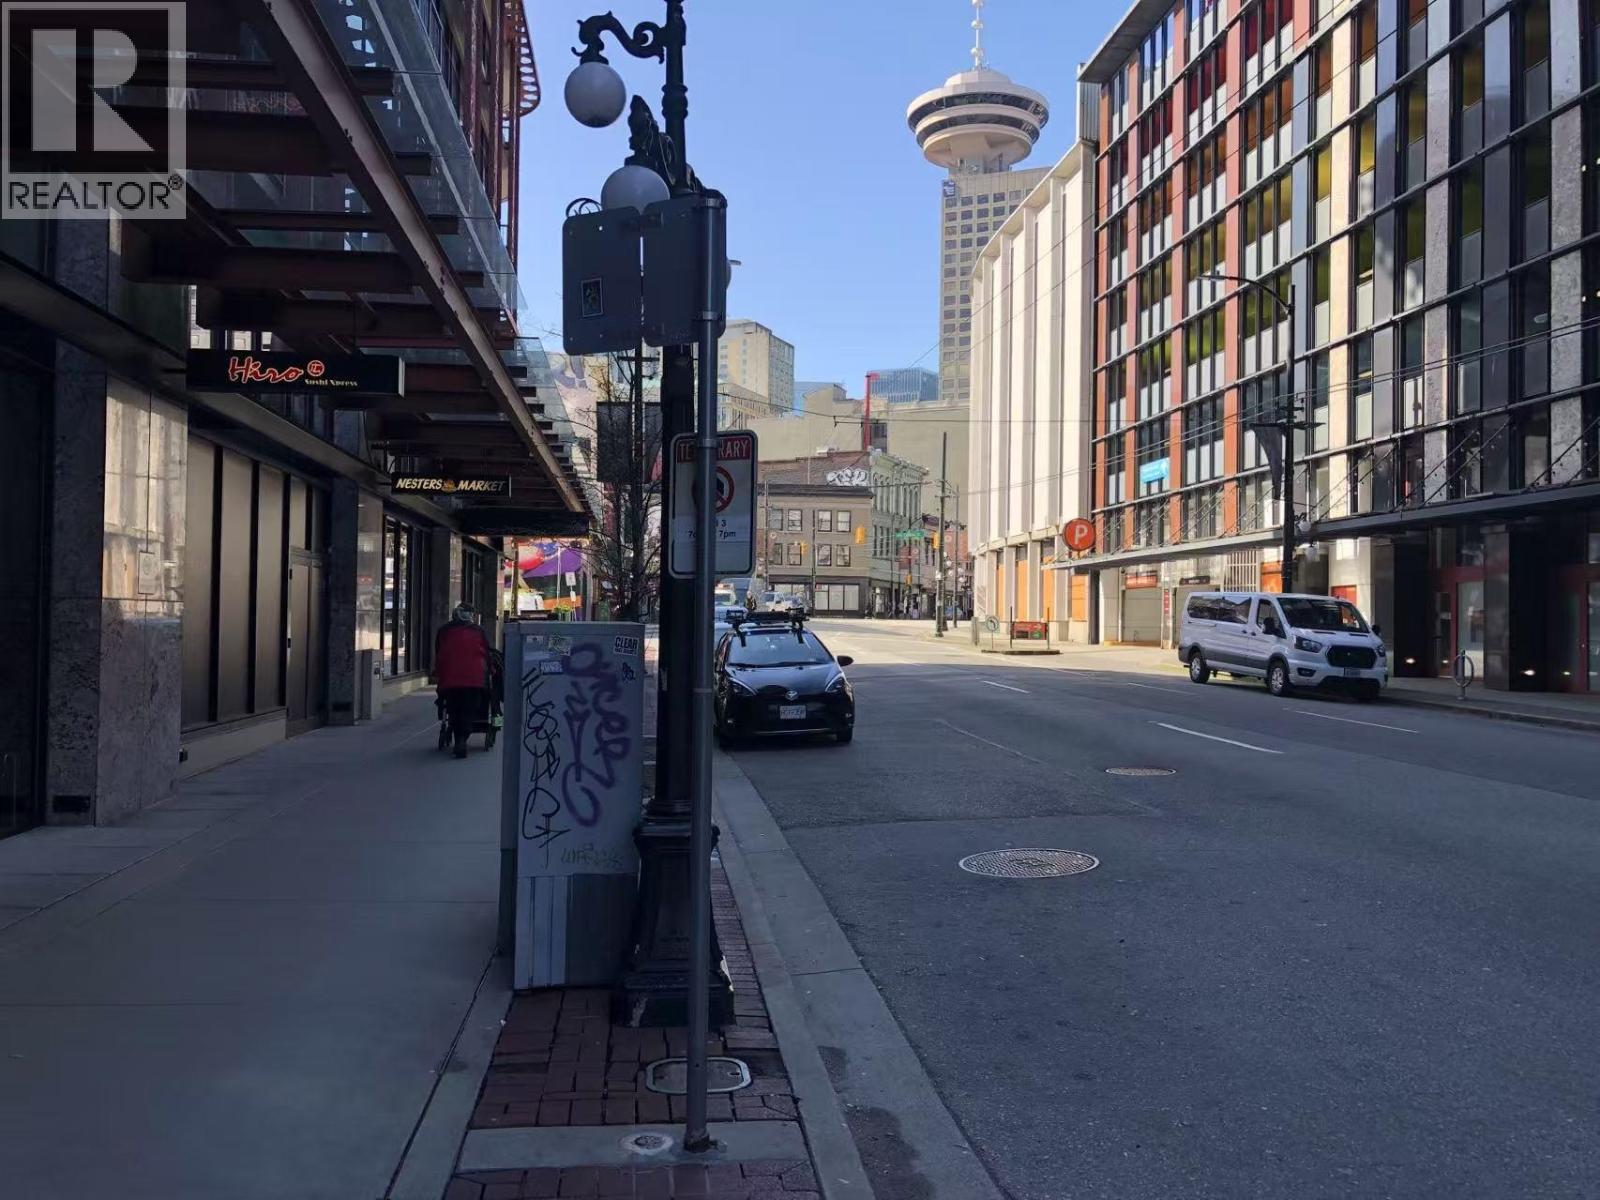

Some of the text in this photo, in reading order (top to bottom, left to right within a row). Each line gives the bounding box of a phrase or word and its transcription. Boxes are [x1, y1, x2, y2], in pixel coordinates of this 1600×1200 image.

[228, 356, 304, 384] Hiro
[395, 478, 507, 492] NESTERS MARKET
[719, 530, 736, 539] 7pm
[1074, 526, 1088, 545] P
